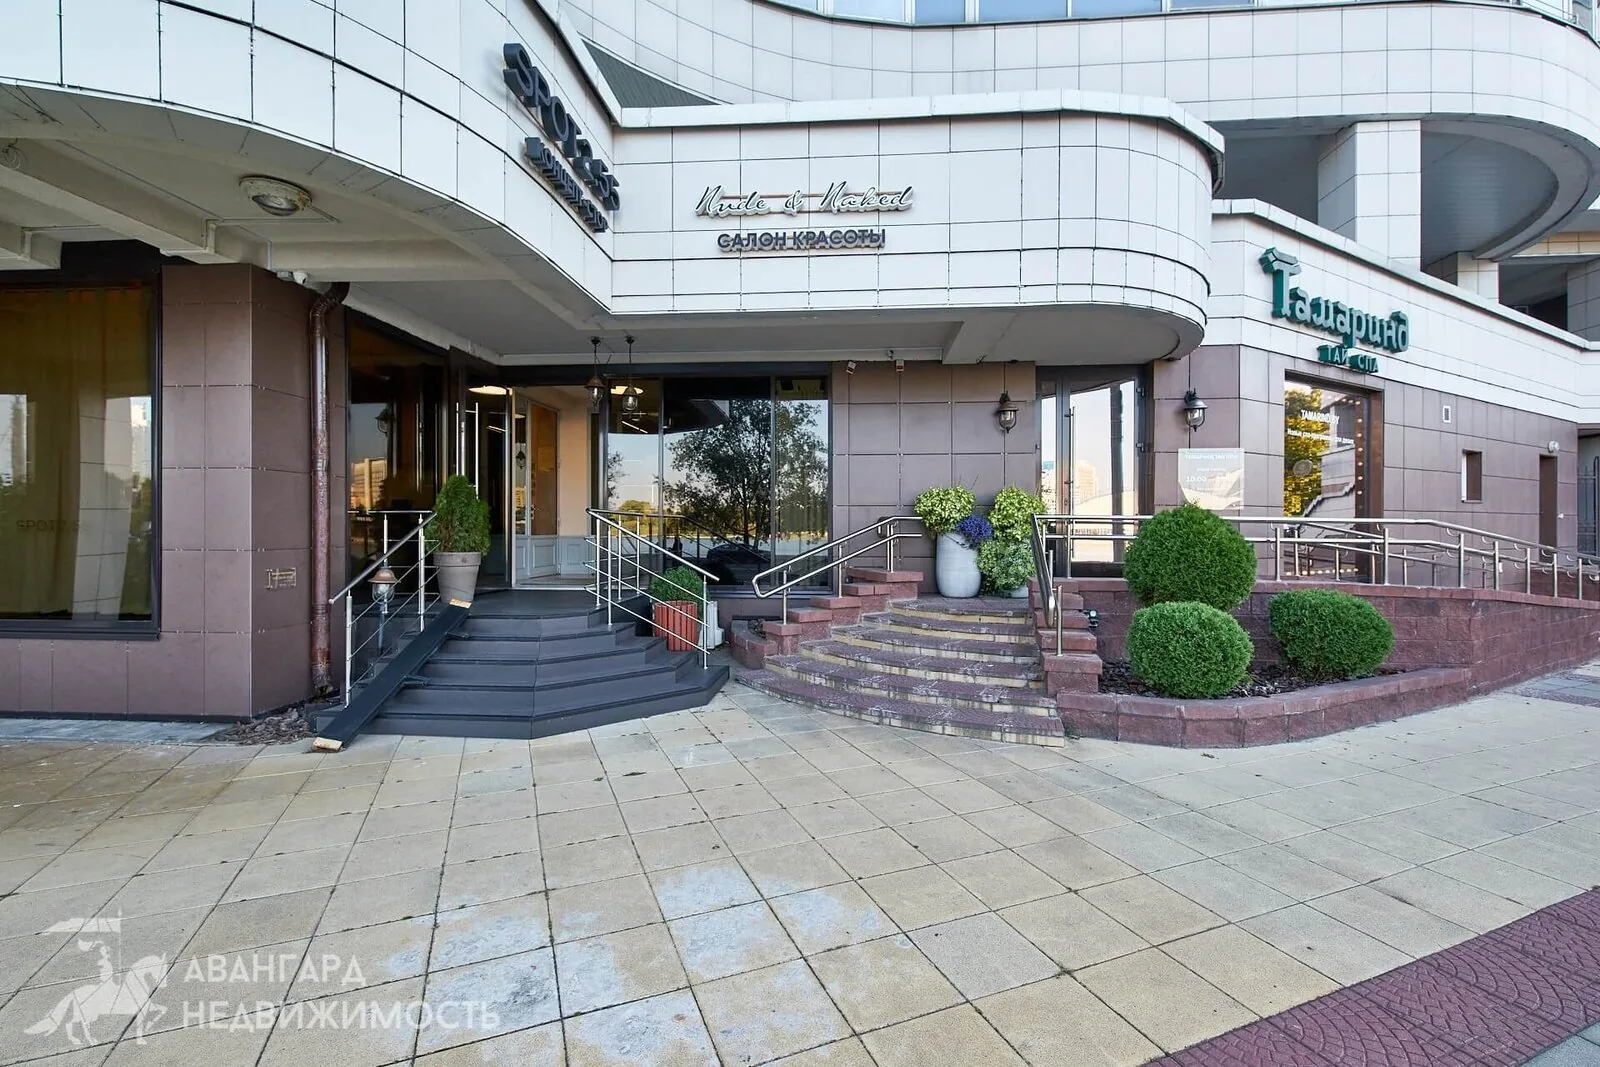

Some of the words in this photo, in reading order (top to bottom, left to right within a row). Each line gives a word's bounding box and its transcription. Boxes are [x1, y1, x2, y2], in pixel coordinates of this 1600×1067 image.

[503, 43, 620, 211] SPOT255
[695, 184, 769, 216] Nude
[818, 181, 914, 213] Naked
[717, 233, 787, 251] САЛОН
[792, 229, 886, 250] КРАСОТЫ
[1258, 247, 1409, 353] Тамаринд
[1317, 344, 1351, 364] ТАЙ
[1350, 354, 1379, 373] СПА
